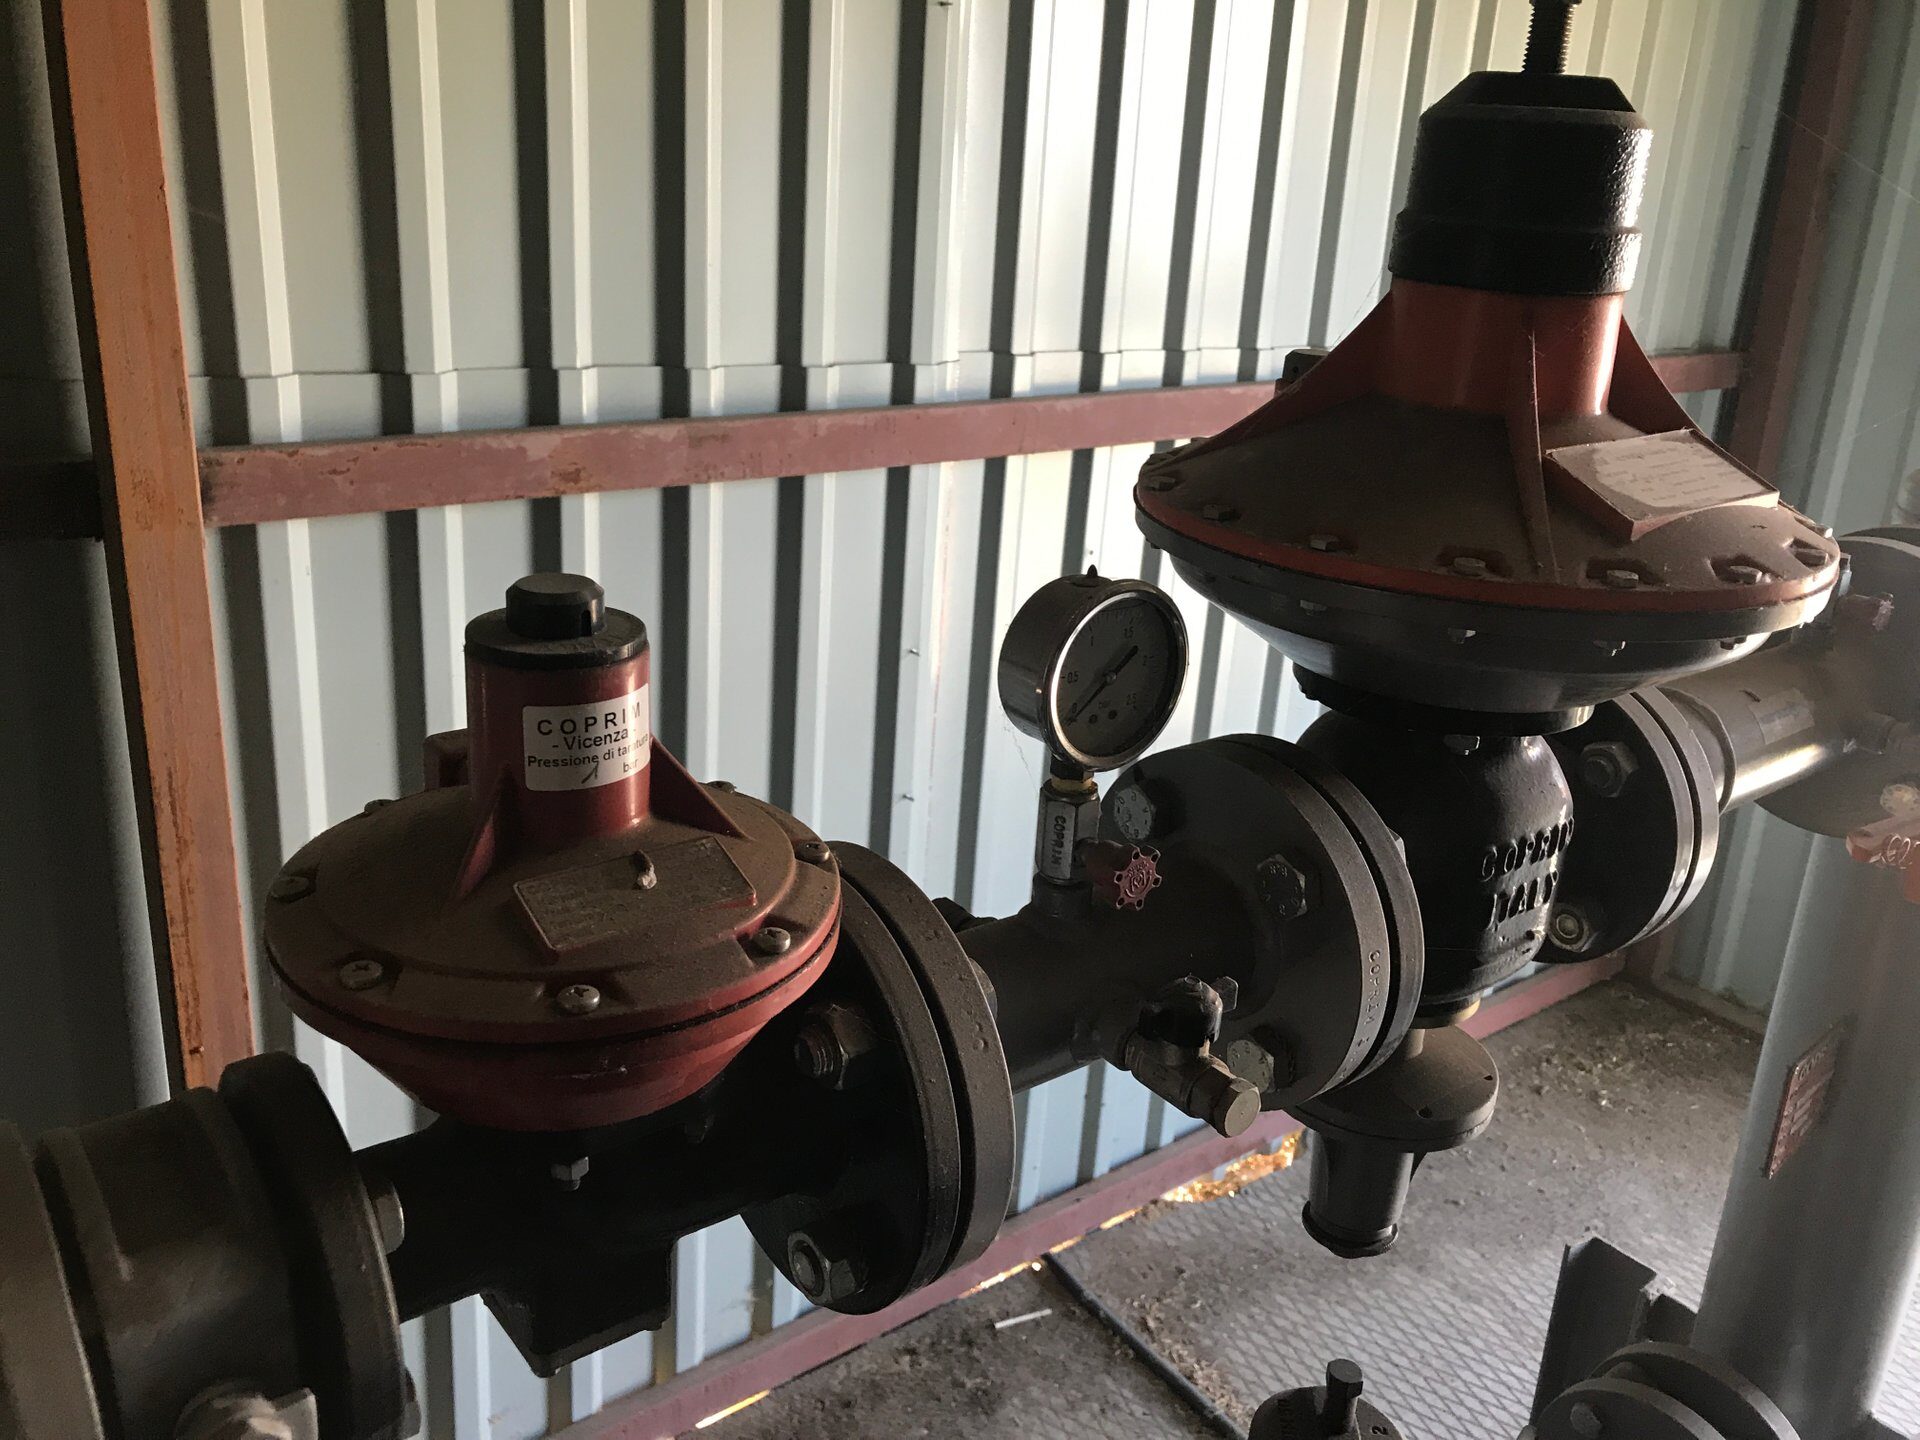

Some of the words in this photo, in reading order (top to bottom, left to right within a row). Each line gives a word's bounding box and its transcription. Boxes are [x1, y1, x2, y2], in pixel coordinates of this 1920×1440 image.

[537, 701, 641, 736] COPRIM
[563, 728, 629, 750] Vicenza
[527, 754, 598, 768] Pressione
[603, 748, 615, 761] di
